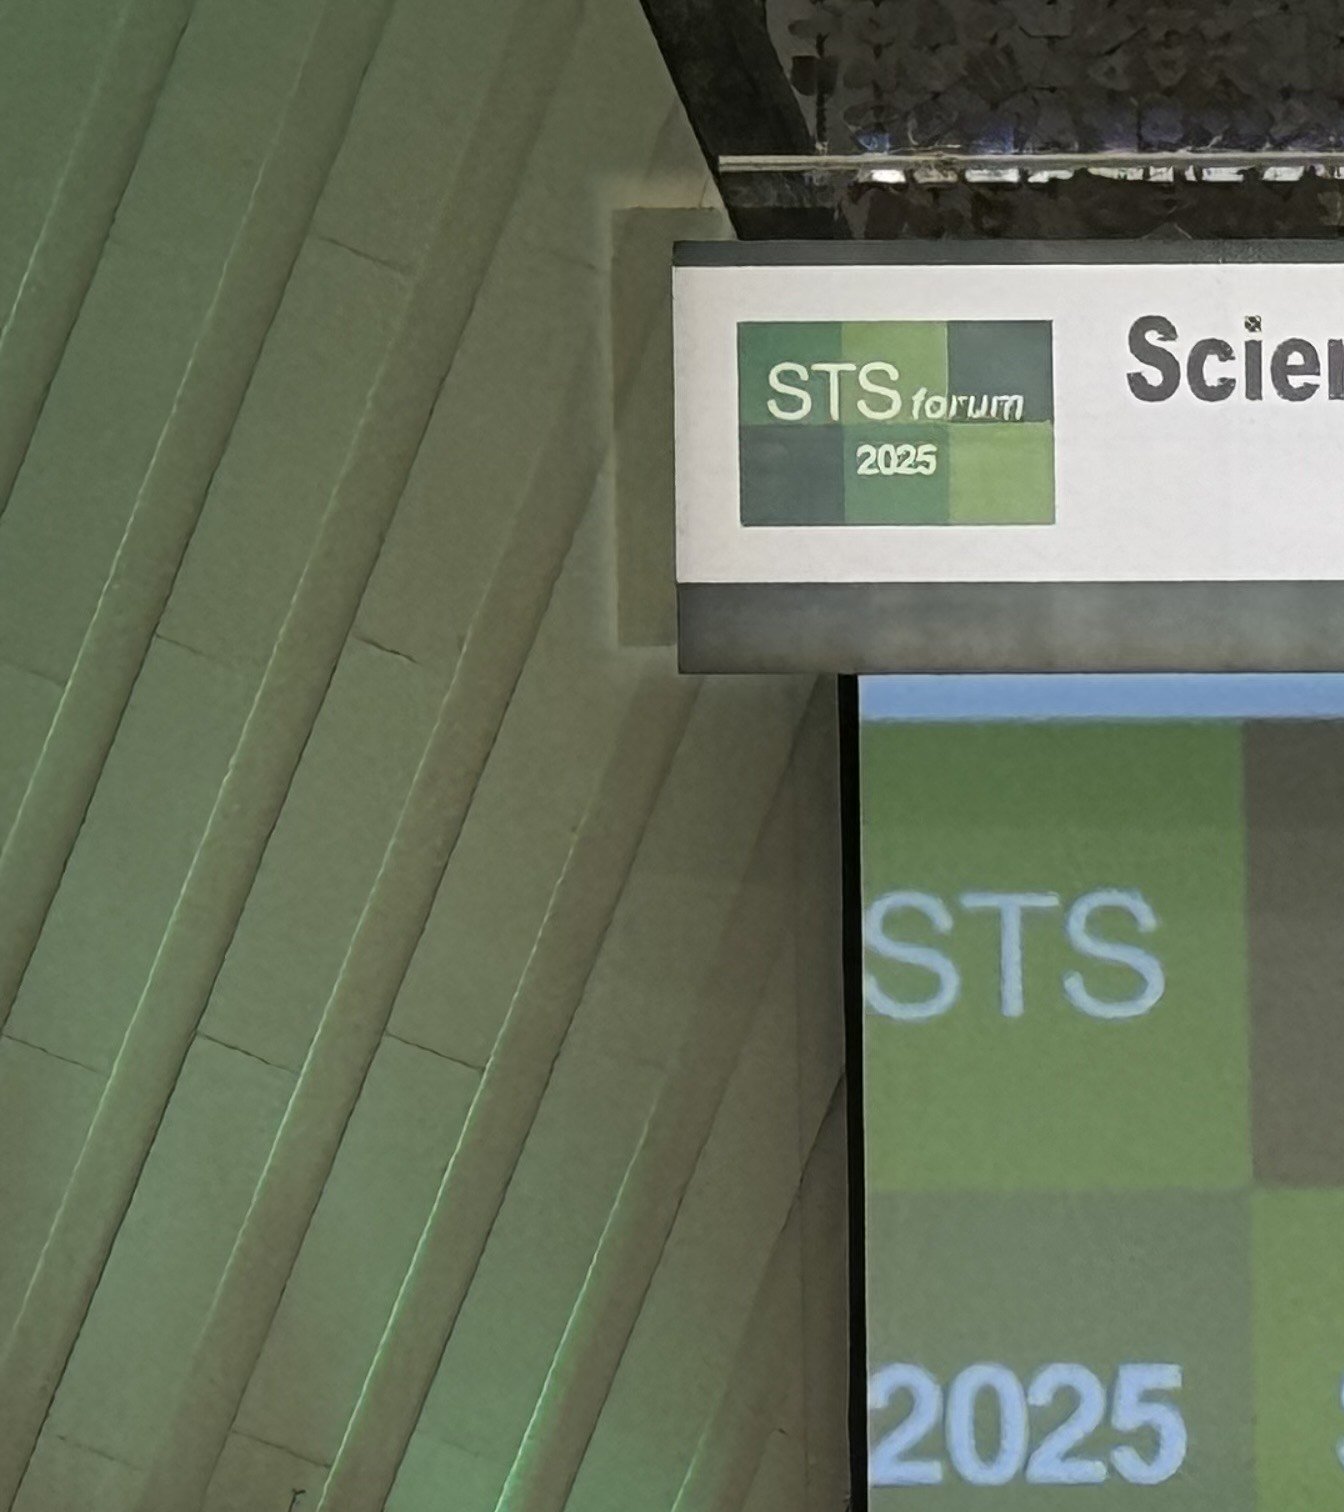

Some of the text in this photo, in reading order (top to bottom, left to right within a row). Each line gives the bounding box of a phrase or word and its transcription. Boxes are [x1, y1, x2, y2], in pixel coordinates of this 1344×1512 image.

[768, 362, 1025, 420] STS forum
[857, 444, 936, 475] 2025
[863, 889, 1164, 1020] STS
[867, 1364, 1186, 1484] 2025
